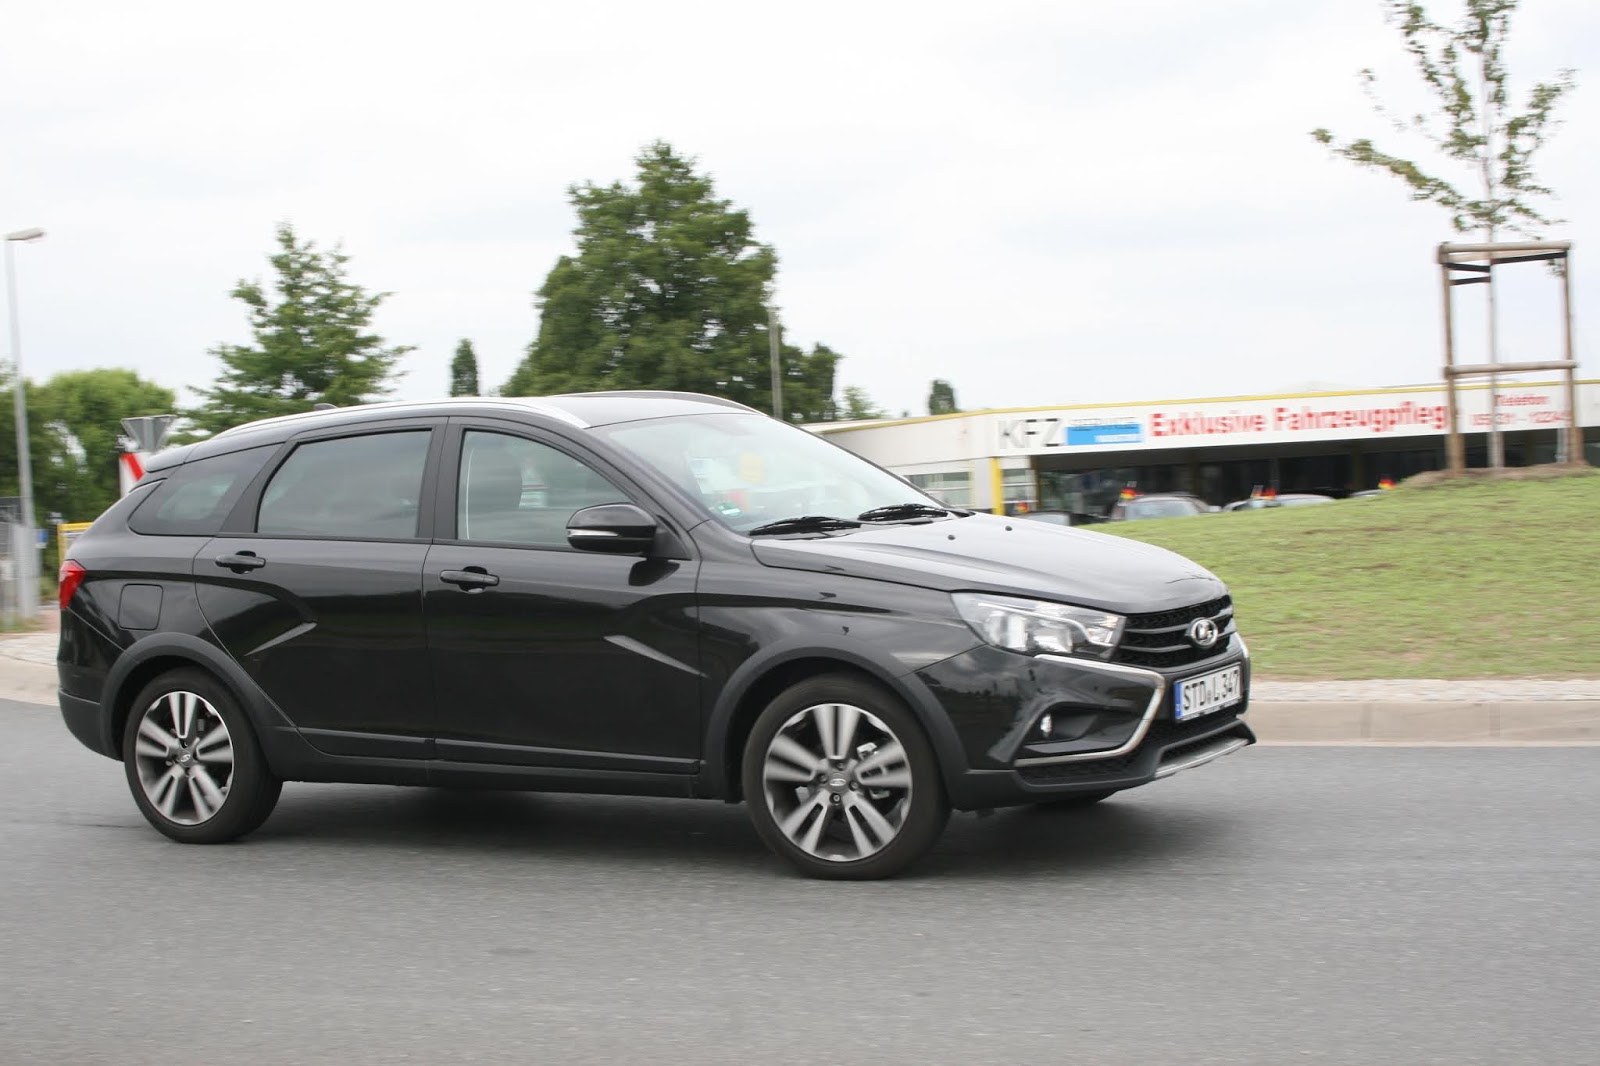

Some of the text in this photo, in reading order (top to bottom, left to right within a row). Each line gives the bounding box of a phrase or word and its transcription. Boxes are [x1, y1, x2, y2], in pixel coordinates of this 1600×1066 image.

[998, 418, 1063, 449] KFZ
[1149, 400, 1457, 436] Exklusive Fahrzeugpfleg
[1184, 680, 1206, 710] STD
